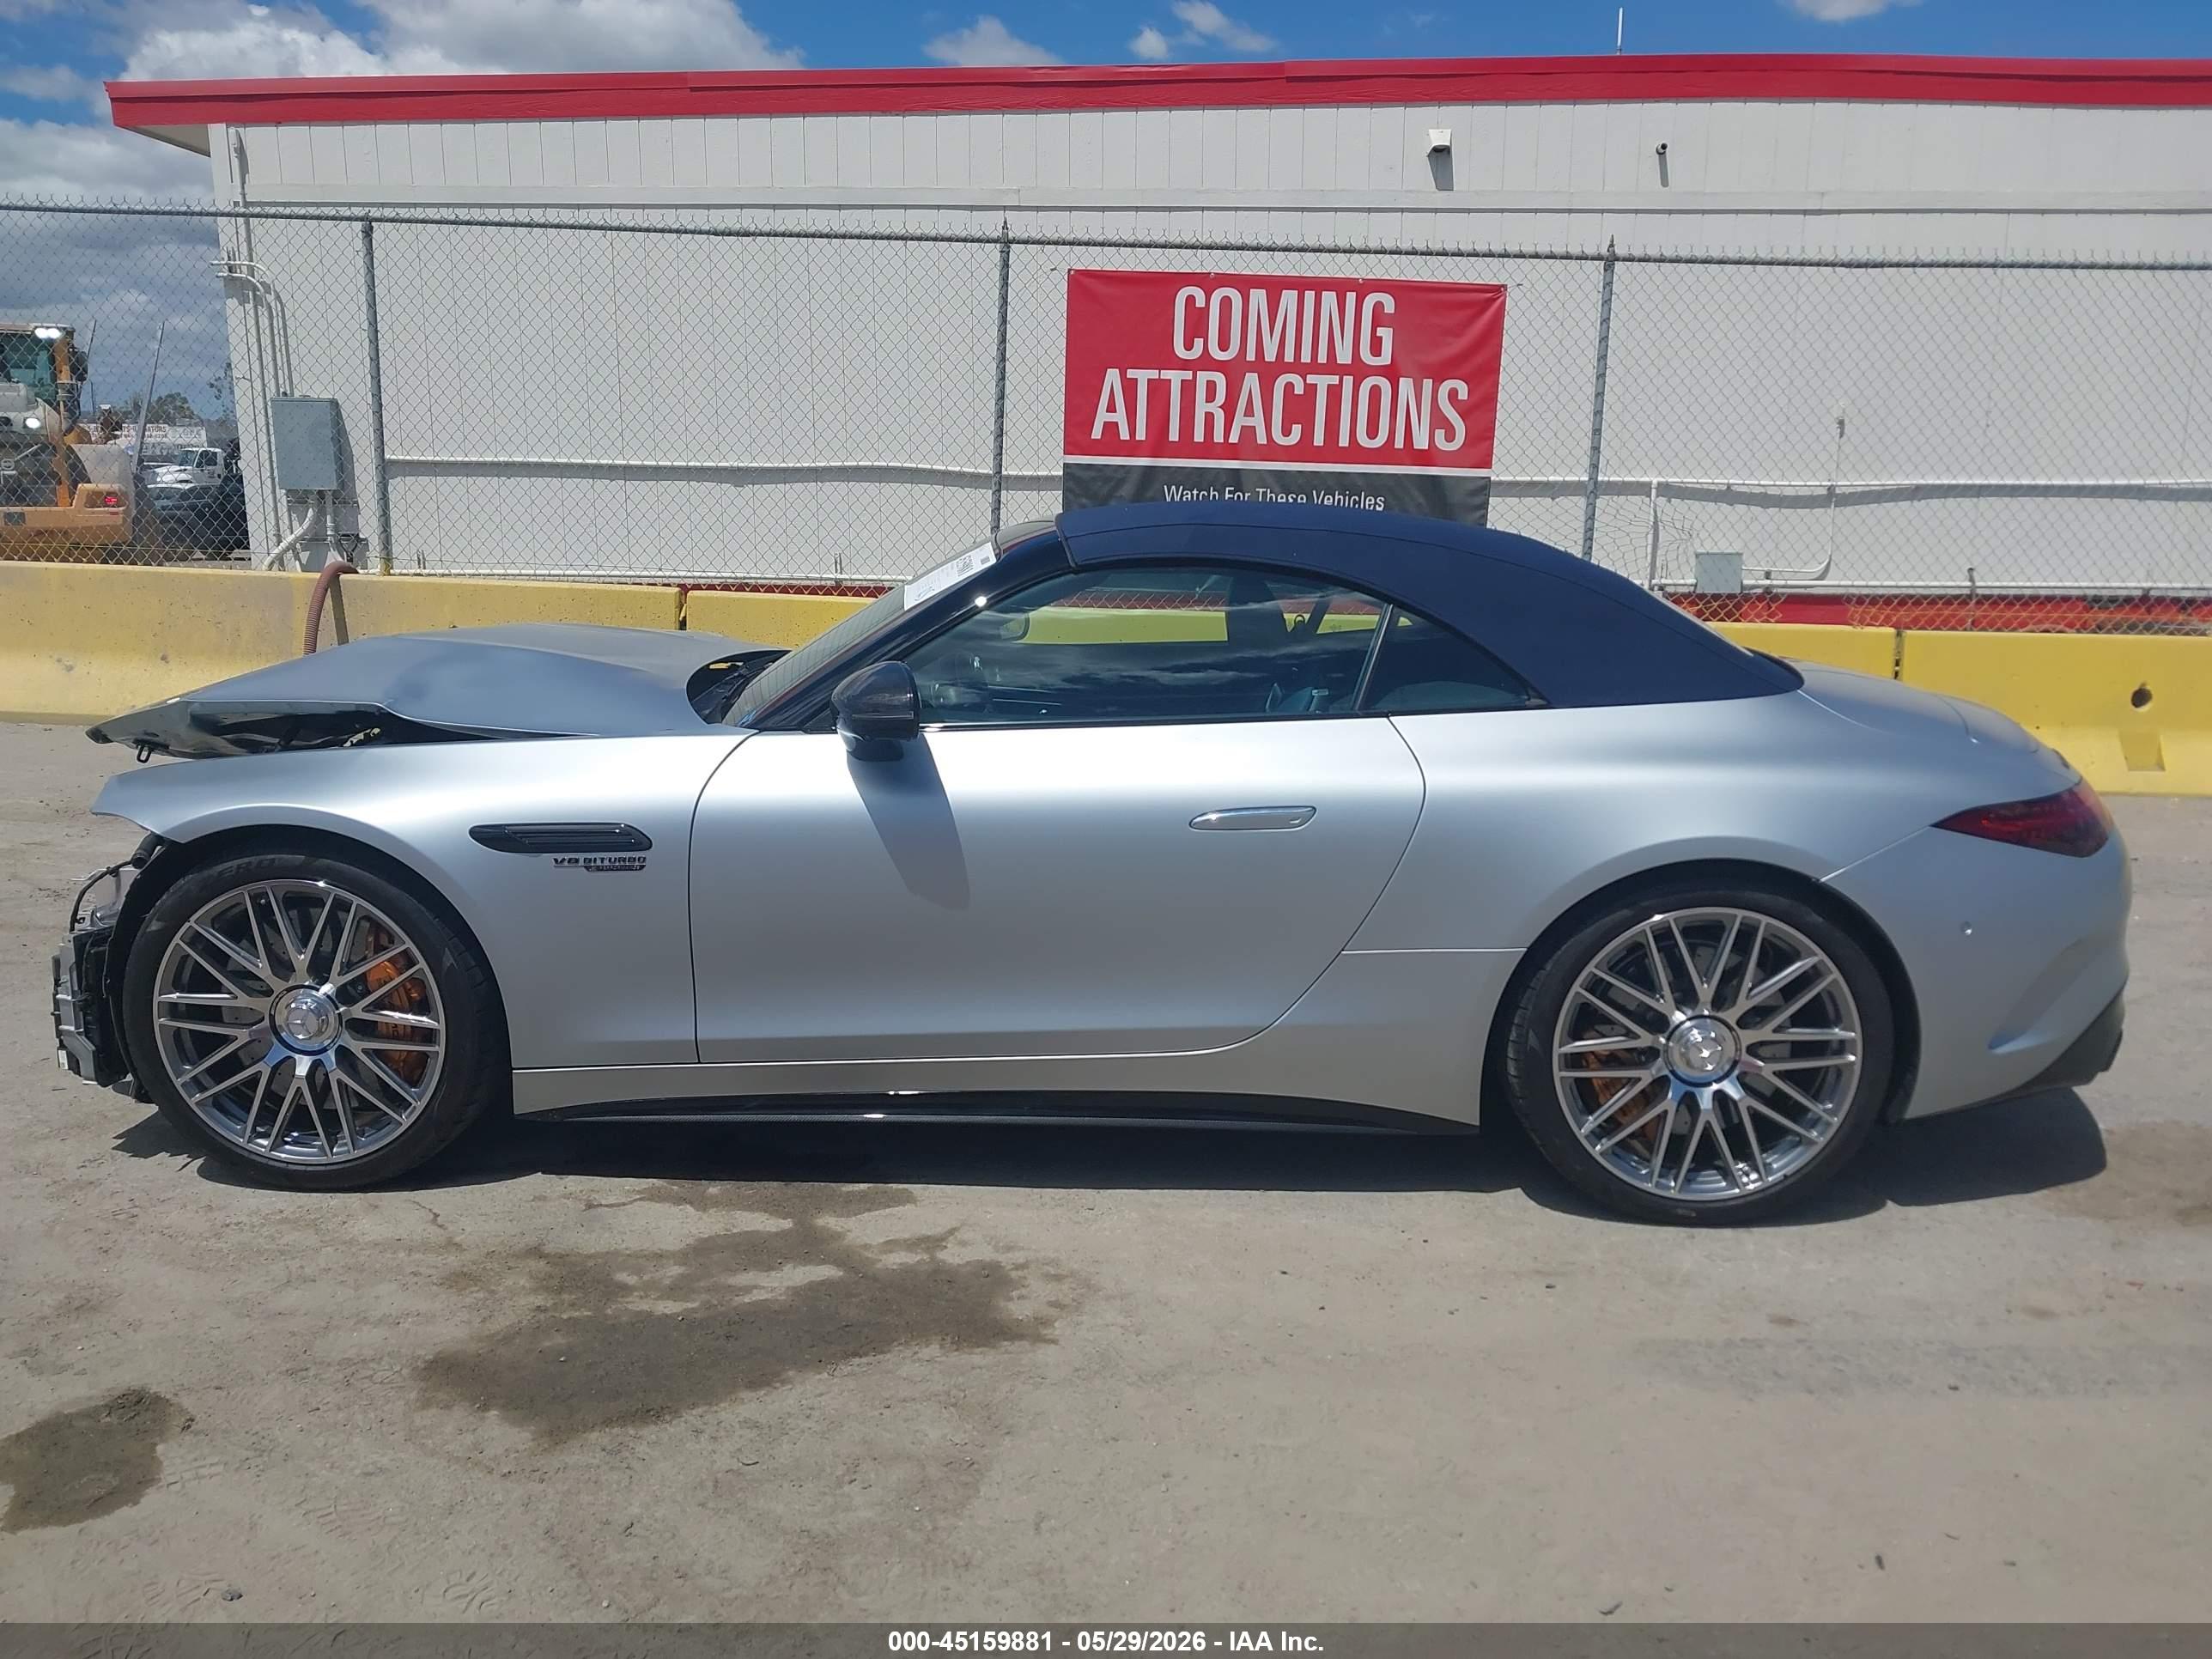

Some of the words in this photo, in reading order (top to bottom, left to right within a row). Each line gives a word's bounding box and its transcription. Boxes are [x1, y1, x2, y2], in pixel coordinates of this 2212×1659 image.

[1173, 286, 1395, 366] COMING
[1091, 368, 1468, 452] ATTRACTIONS
[1163, 484, 1219, 502] Watch
[1224, 487, 1251, 501] For
[1255, 488, 1308, 504] These
[1312, 489, 1386, 512] Vehicles
